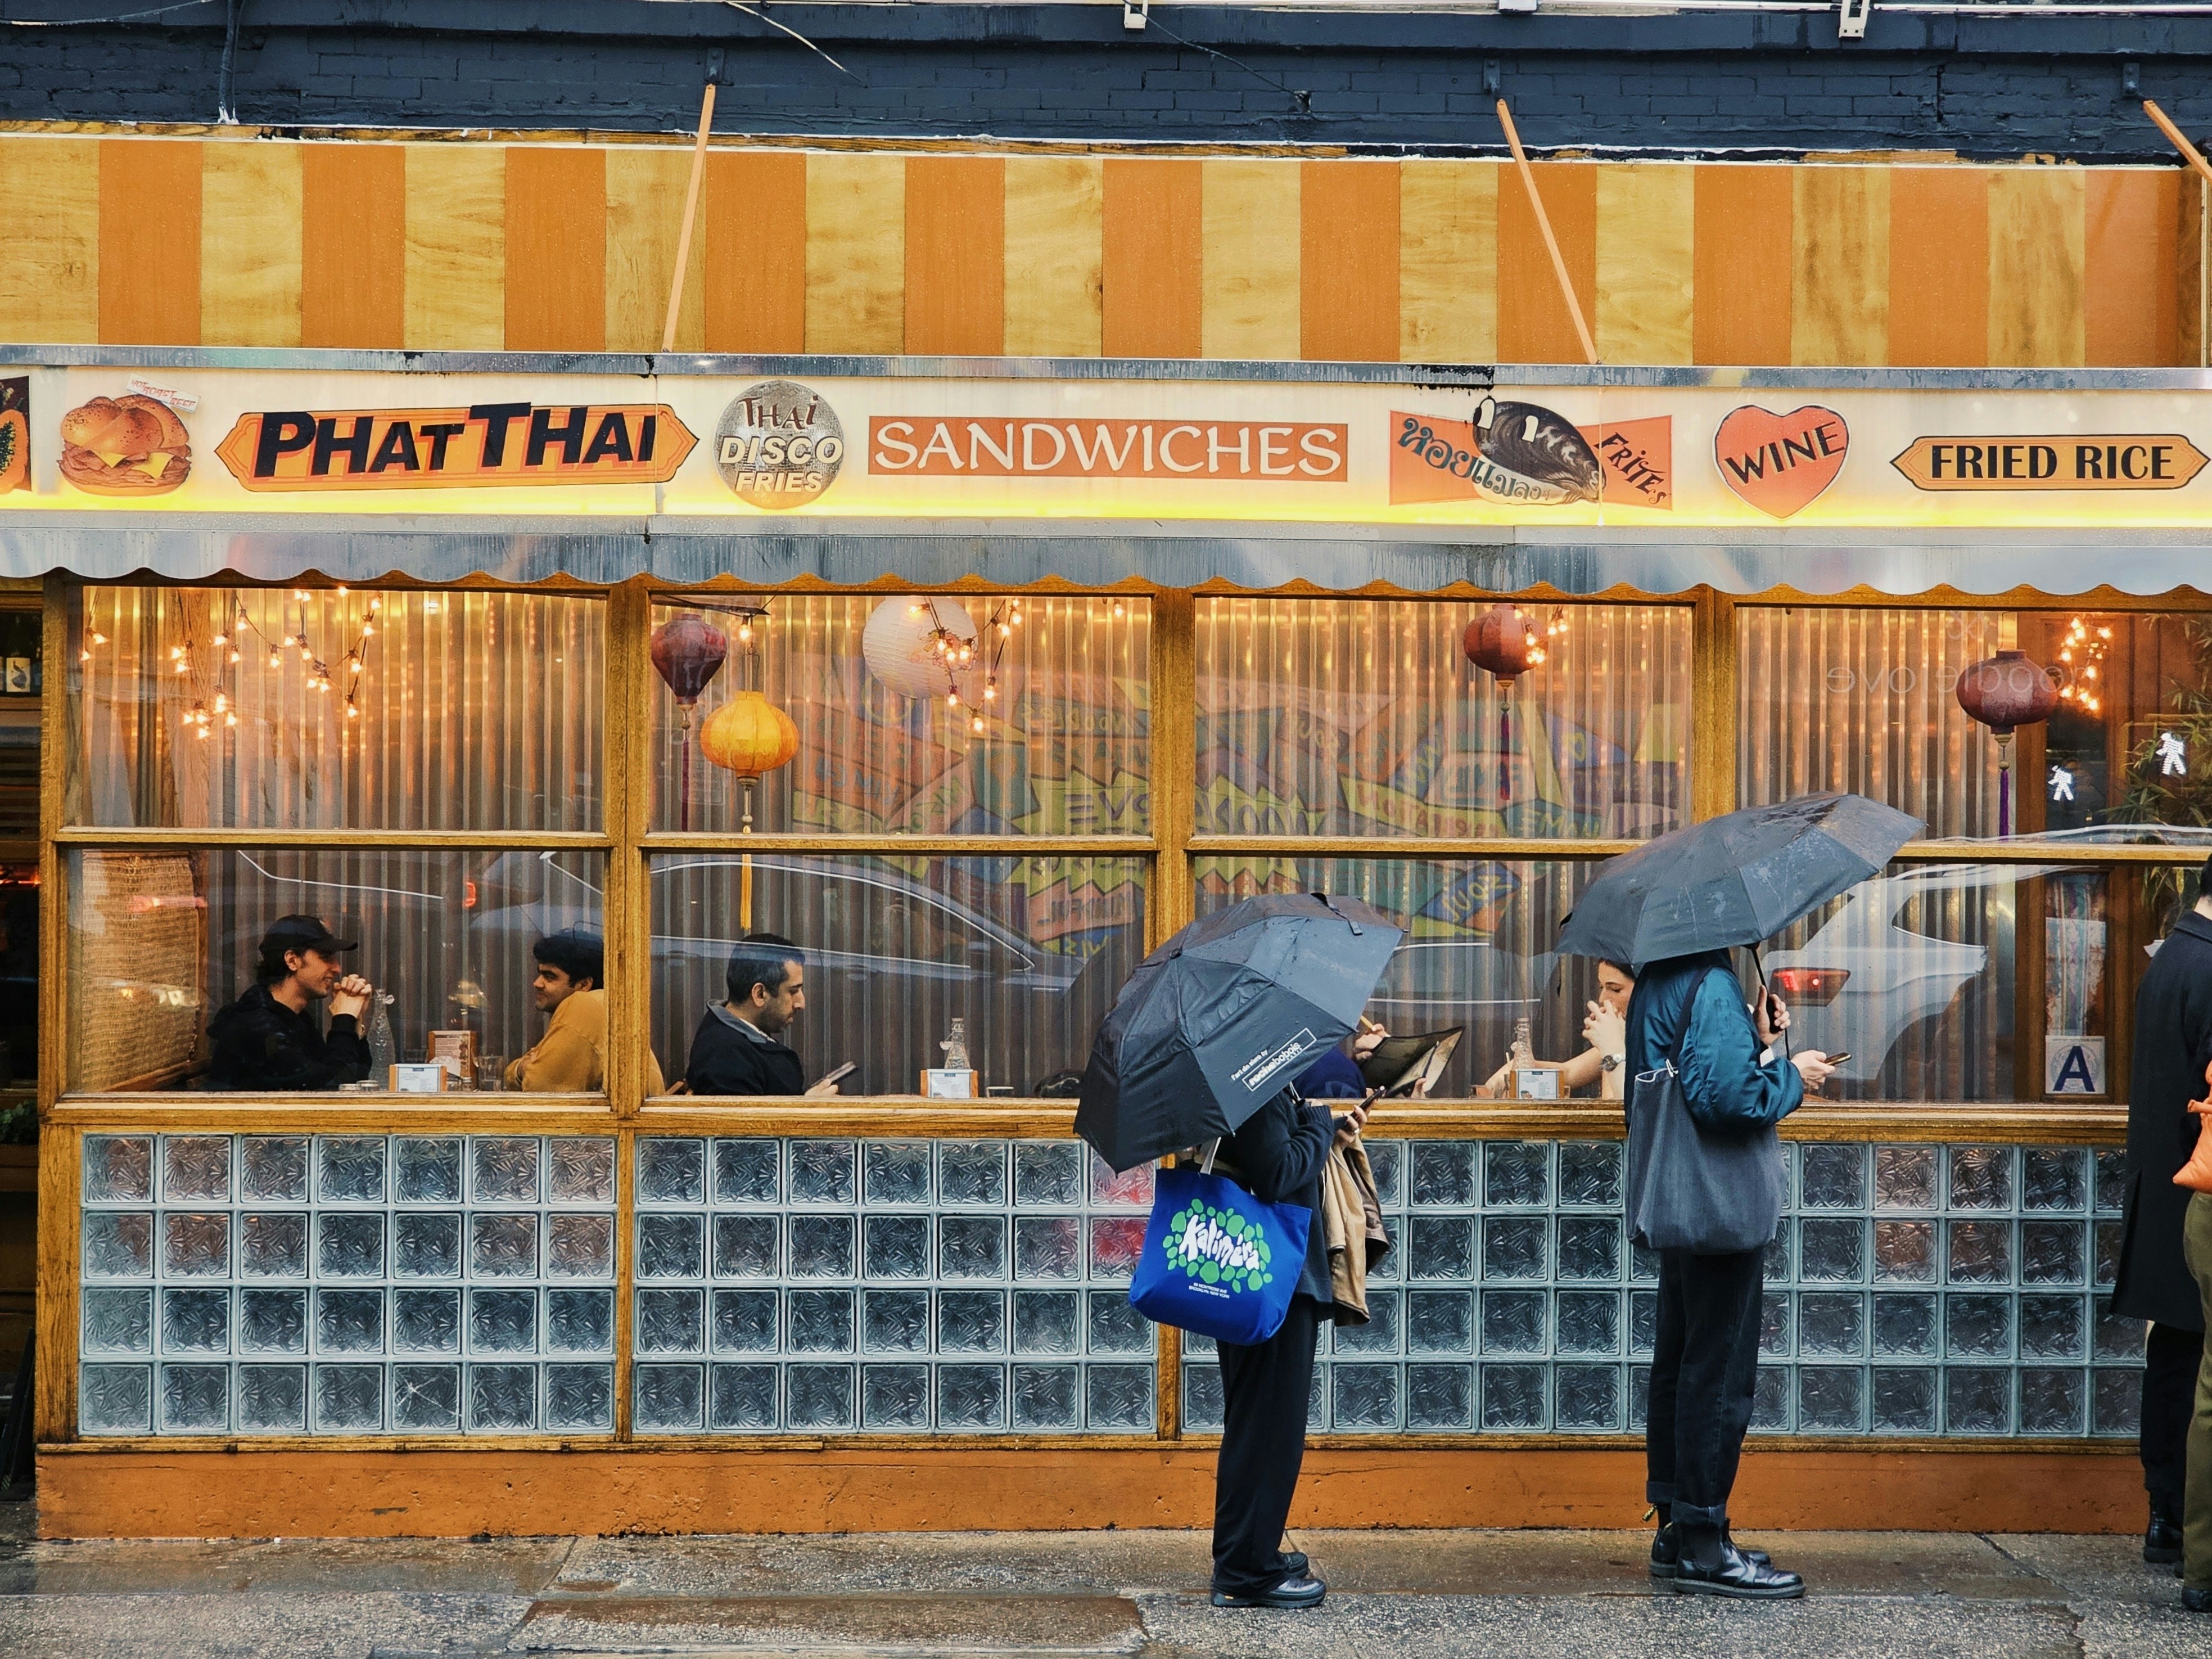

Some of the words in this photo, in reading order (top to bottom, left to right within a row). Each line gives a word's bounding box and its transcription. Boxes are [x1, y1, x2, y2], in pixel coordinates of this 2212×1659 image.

[130, 379, 149, 390] HOT
[143, 386, 178, 399] ROAST
[254, 411, 465, 479] PHAT
[468, 402, 656, 468] THAI
[719, 435, 843, 465] DISCO
[875, 421, 1342, 476] SANDWICHES
[1725, 420, 1846, 486] WINE
[1931, 444, 2058, 480] FRIED
[2075, 444, 2175, 480] RICE
[735, 471, 823, 493] FRIES
[2052, 1045, 2096, 1092] A
